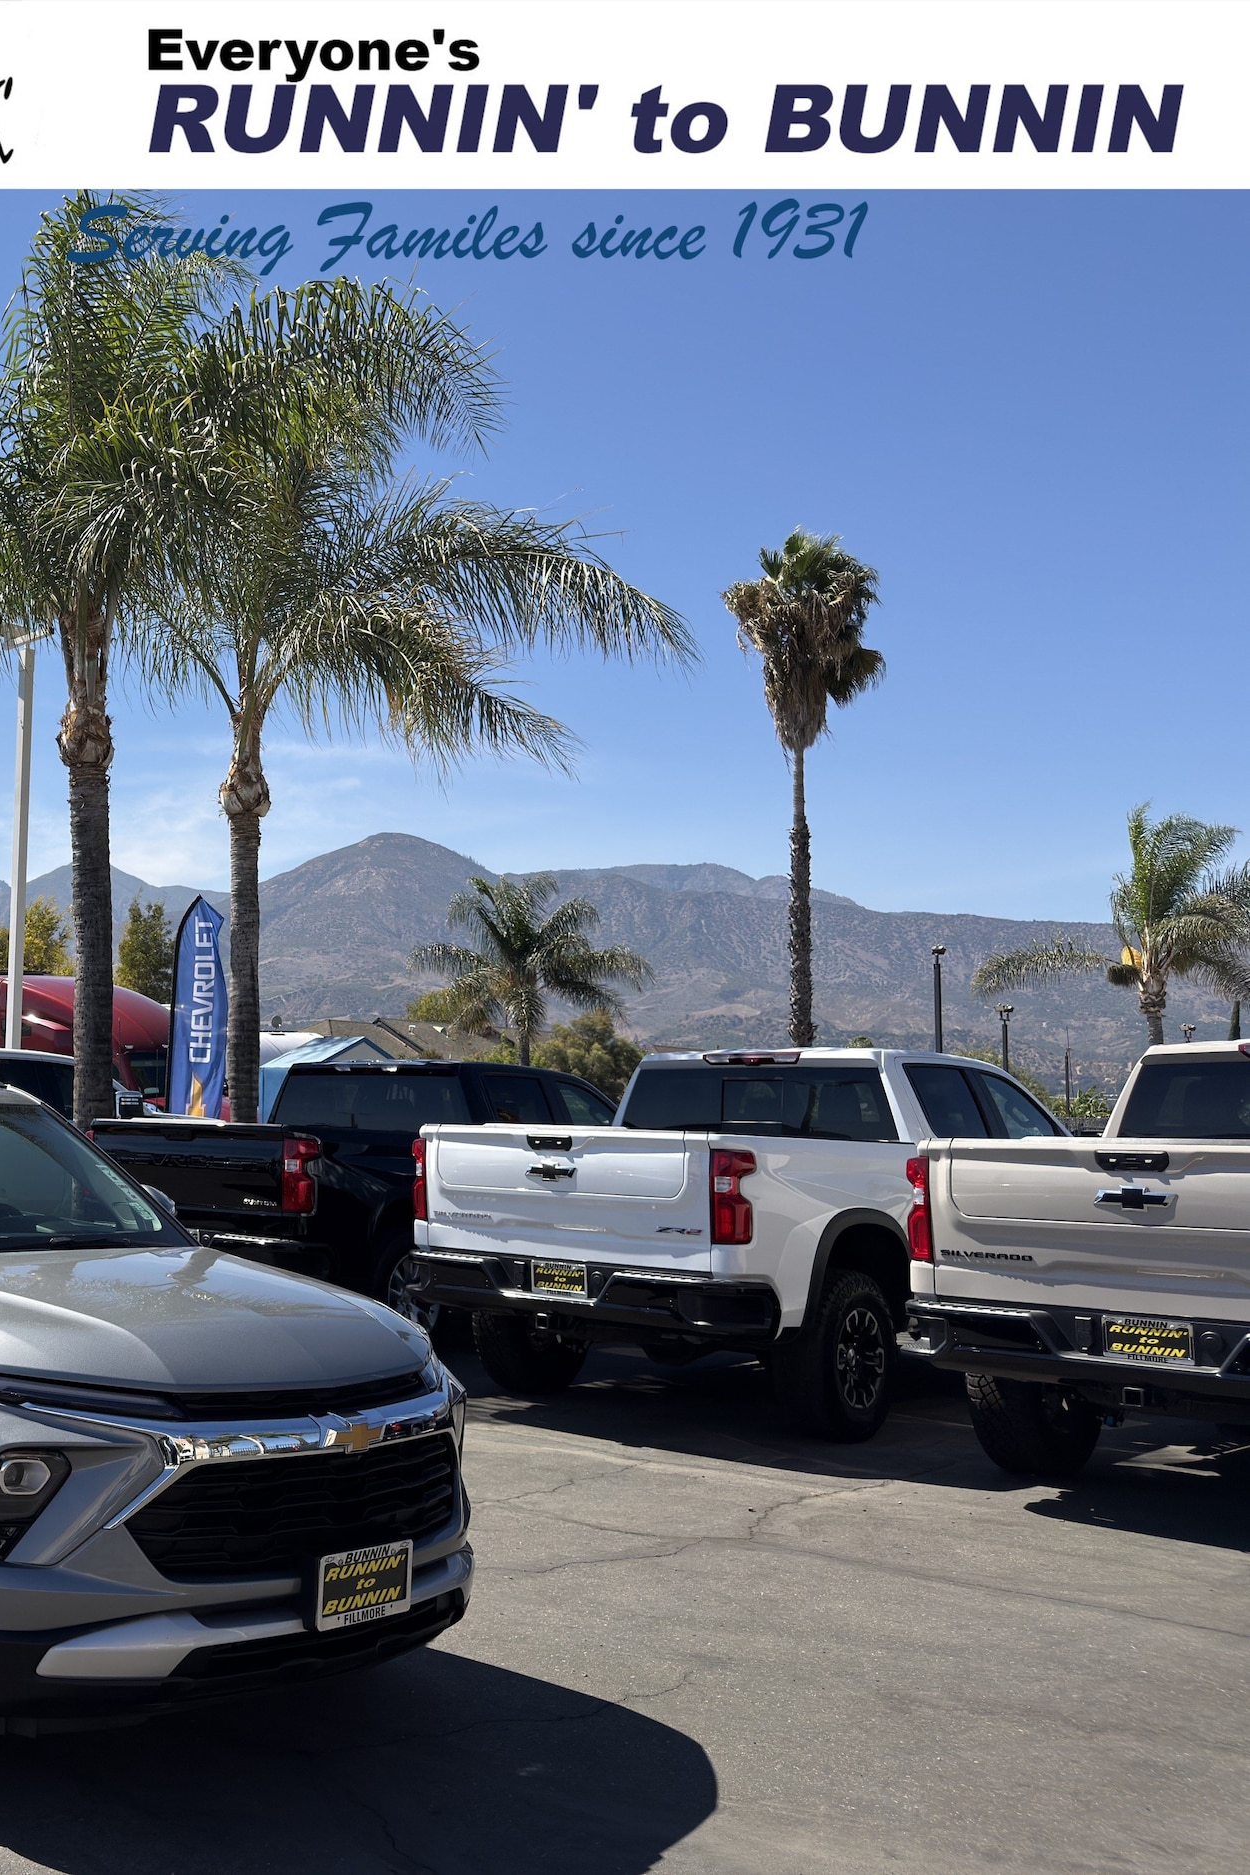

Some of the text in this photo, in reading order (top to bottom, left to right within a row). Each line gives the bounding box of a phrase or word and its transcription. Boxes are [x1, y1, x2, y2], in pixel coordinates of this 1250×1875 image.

[189, 915, 216, 1064] CHEVROLET
[940, 1249, 1034, 1262] SILVERADO
[535, 1267, 585, 1278] RUNNIN'
[554, 1275, 567, 1283] to
[536, 1281, 583, 1292] BUNNIN
[1124, 1318, 1168, 1329] BUNNIN
[1109, 1324, 1189, 1339] RUNNIN'
[1139, 1336, 1160, 1345] to
[1110, 1342, 1186, 1358] BUNNIN
[345, 1545, 391, 1565] BUNNIN
[325, 1554, 407, 1583] RUNNIN'
[356, 1577, 376, 1591] to
[323, 1585, 402, 1616] BUNNIN
[344, 1605, 386, 1626] FILLMORE
